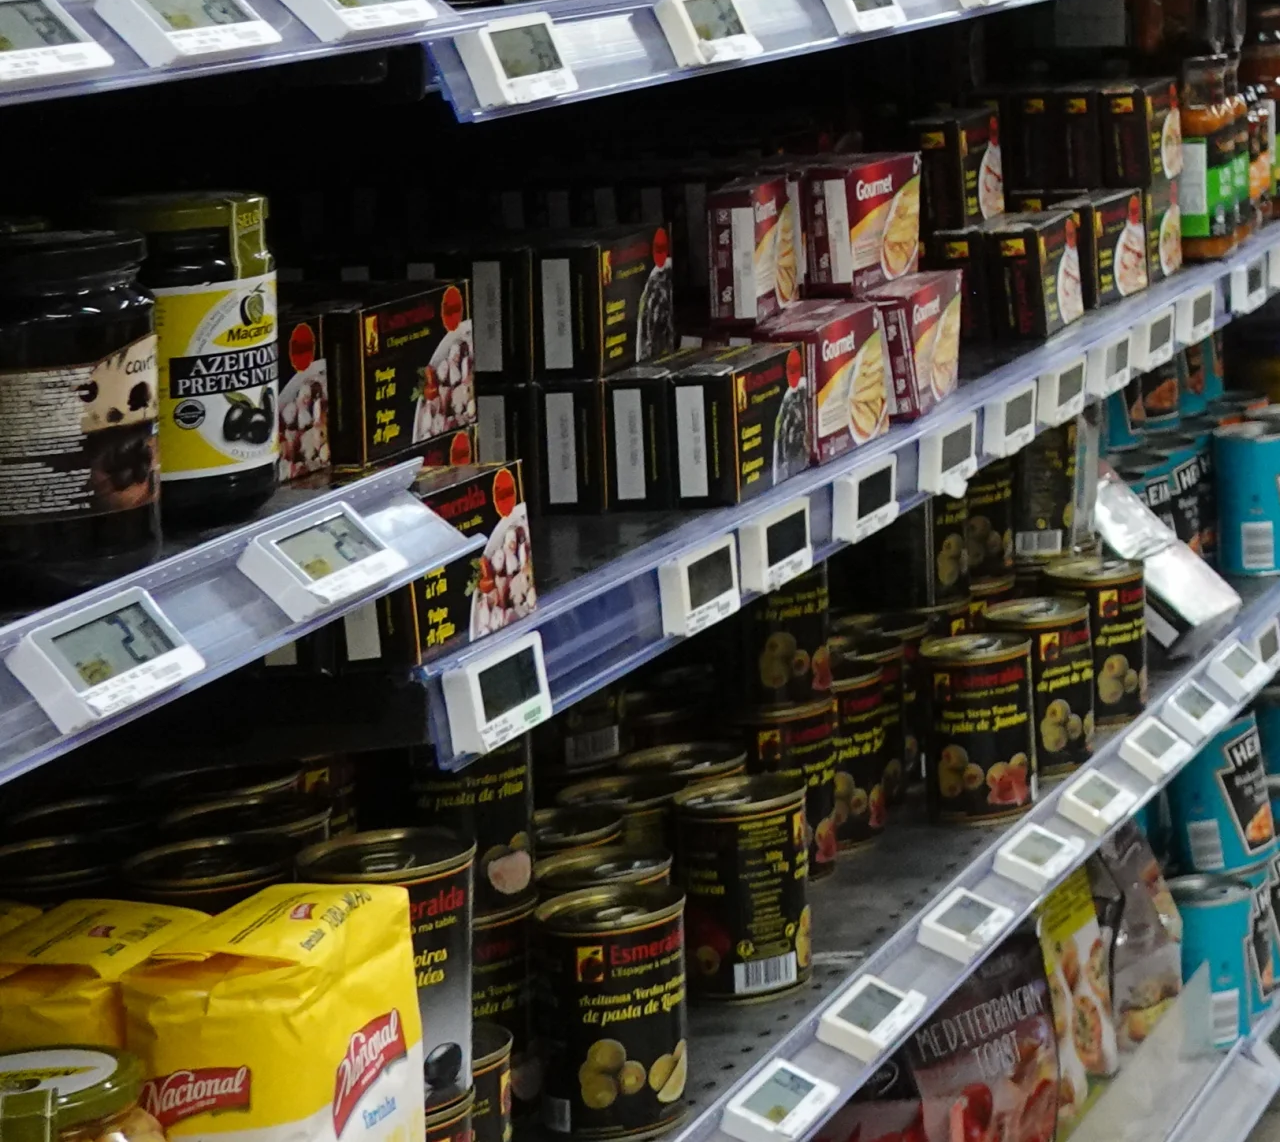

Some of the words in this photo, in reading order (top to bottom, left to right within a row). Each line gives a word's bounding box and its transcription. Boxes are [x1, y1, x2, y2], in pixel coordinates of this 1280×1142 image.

[855, 173, 894, 202] Gourmet
[821, 330, 856, 363] Gourmet
[177, 370, 250, 396] PRETAS
[1231, 734, 1261, 764] HEI
[410, 885, 465, 922] eralda
[413, 947, 448, 968] oires
[582, 1008, 600, 1025] de
[601, 1004, 642, 1027] pasta
[914, 981, 1045, 1063] MEDITERRANEAN
[142, 1064, 249, 1118] Nacional
